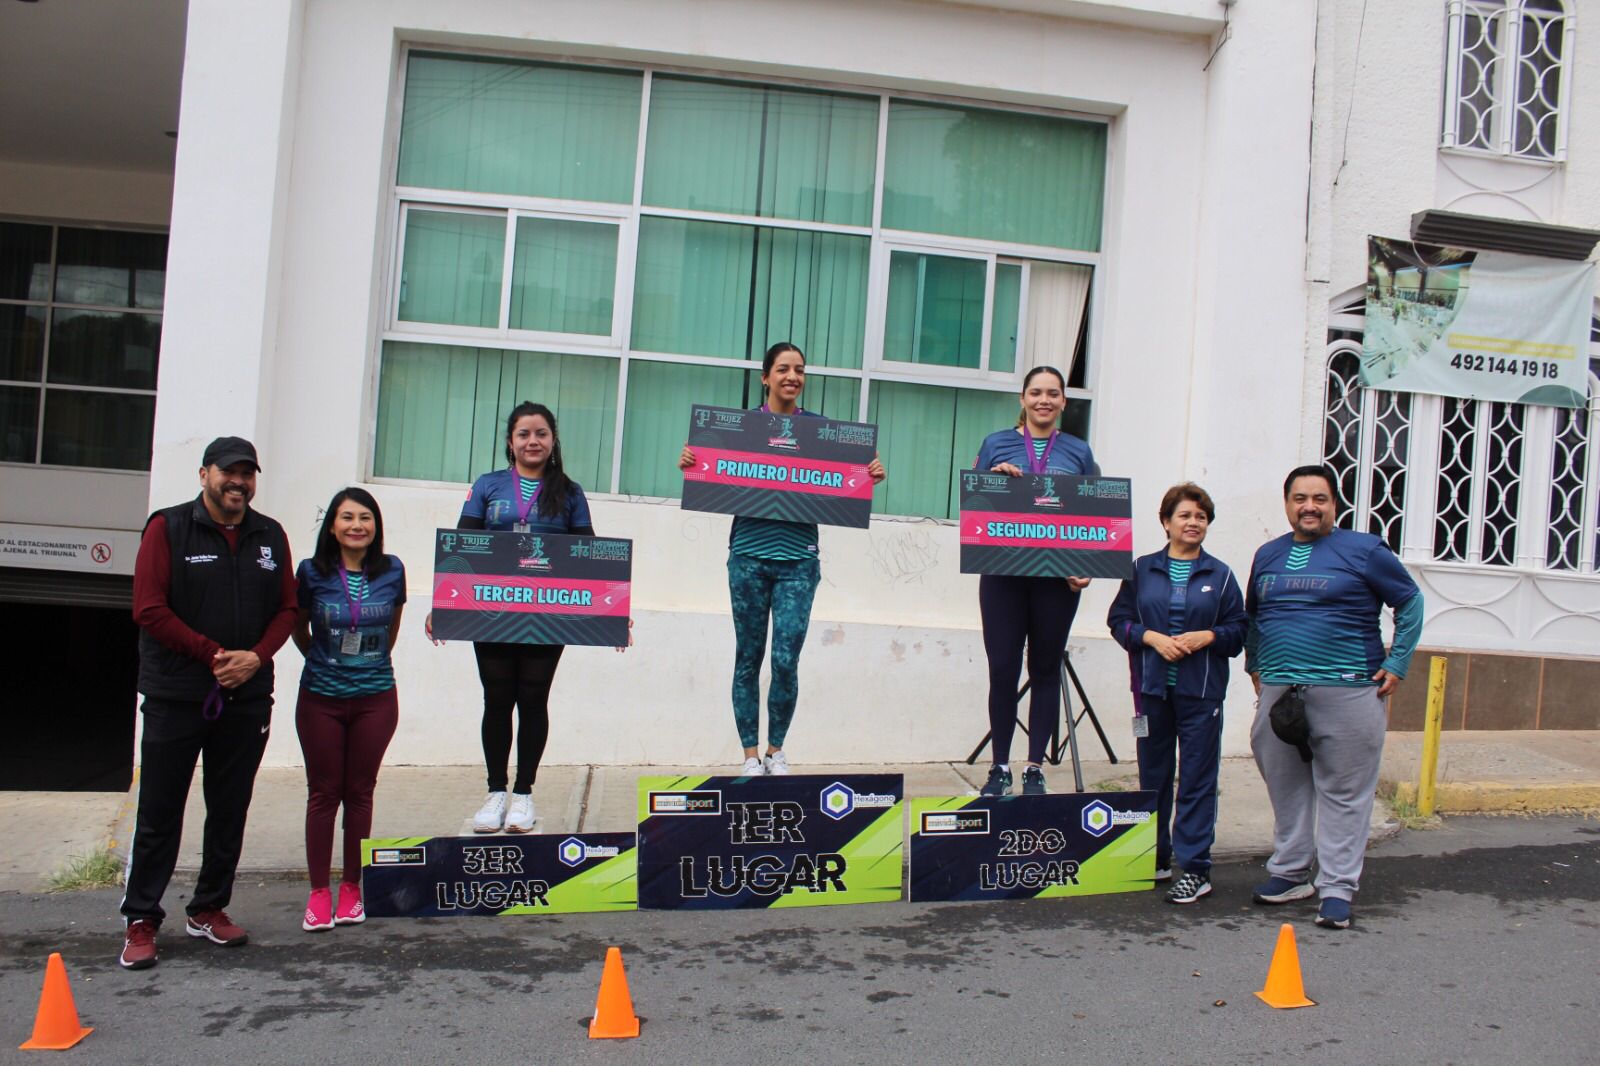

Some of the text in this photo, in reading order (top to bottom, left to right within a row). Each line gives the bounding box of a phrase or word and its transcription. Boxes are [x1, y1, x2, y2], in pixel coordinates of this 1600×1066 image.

[716, 459, 844, 488] PRIMERO LUGAR
[18, 540, 87, 550] ESTACIONAMIENTO
[462, 536, 490, 545] TRIJEZ
[987, 521, 1108, 541] SEGUNDO LUGAR
[41, 550, 77, 558] TRIBUNAL
[473, 585, 593, 606] TERCER LUGAR
[1285, 578, 1329, 591] TRIJEZ
[726, 801, 807, 844] 1ER
[998, 828, 1066, 857] 2DO
[462, 845, 525, 875] 3ER
[680, 853, 848, 898] LUGAR
[979, 860, 1080, 890] LUGAR
[436, 879, 549, 910] LUGAR
